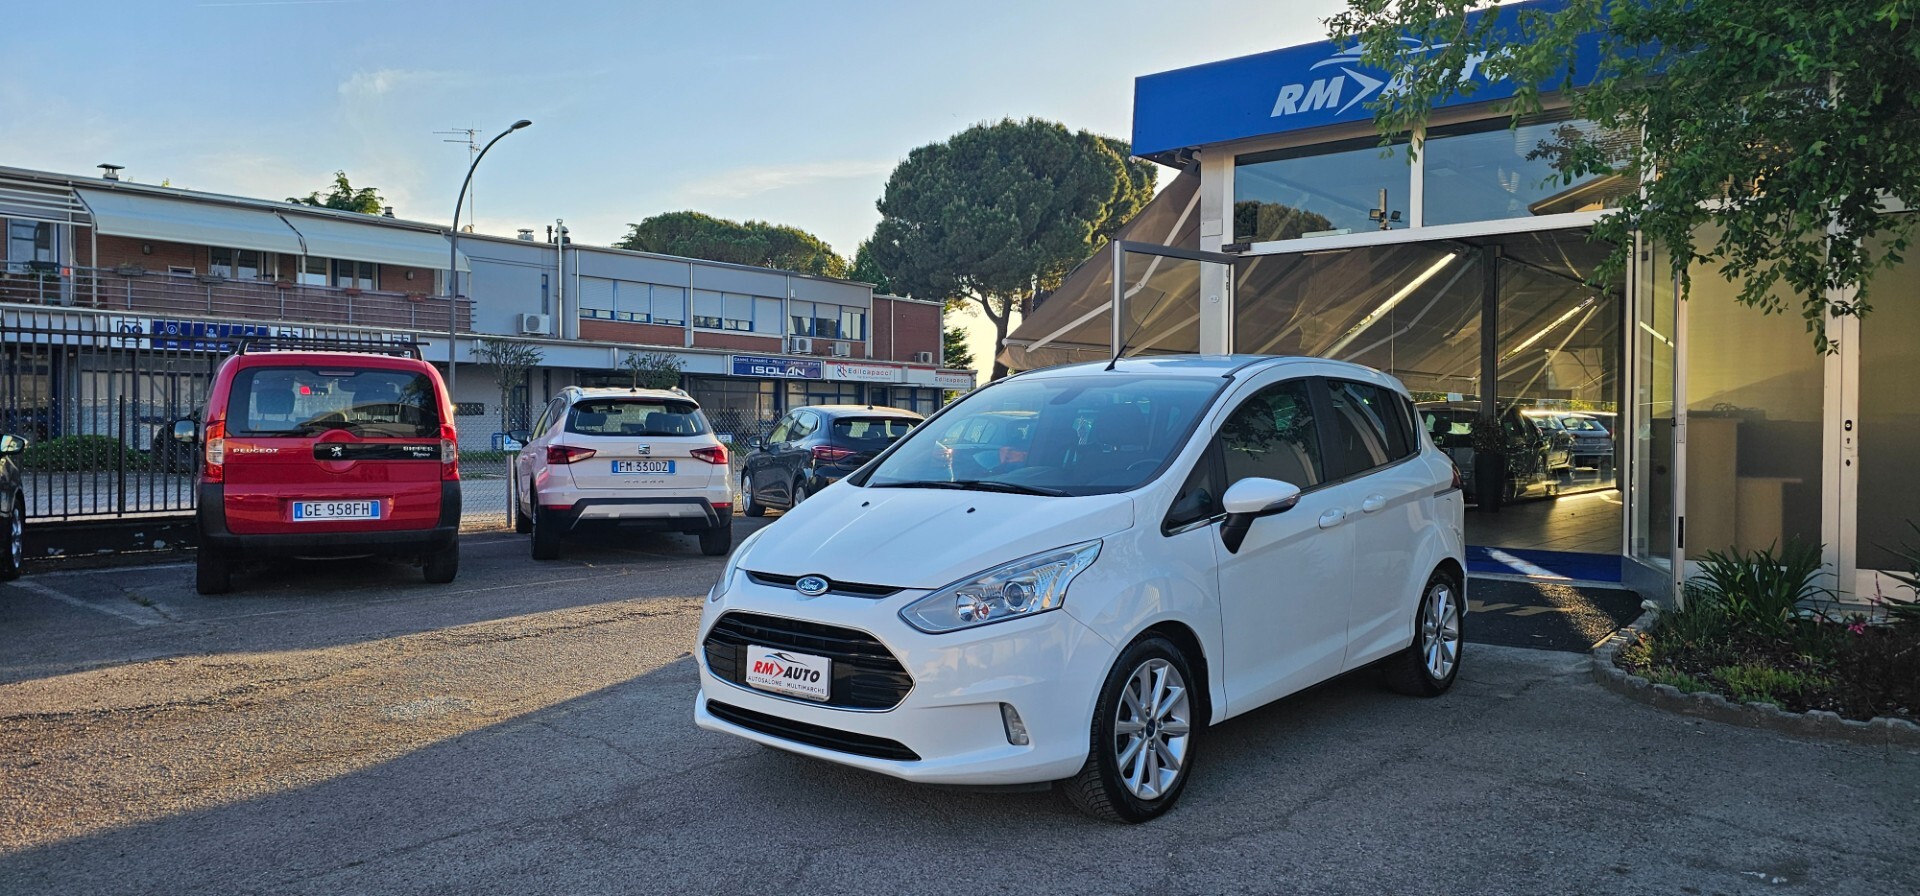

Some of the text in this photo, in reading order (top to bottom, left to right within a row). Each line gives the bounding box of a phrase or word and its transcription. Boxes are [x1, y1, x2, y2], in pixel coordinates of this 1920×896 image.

[1270, 75, 1345, 118] RM
[751, 365, 805, 377] ISOLAN
[848, 367, 892, 376] Edilcapacci
[801, 579, 820, 590] Ford
[782, 666, 821, 683] AUTO
[748, 675, 783, 686] AUTOSALONE
[786, 682, 825, 694] MULTIMARCHE
